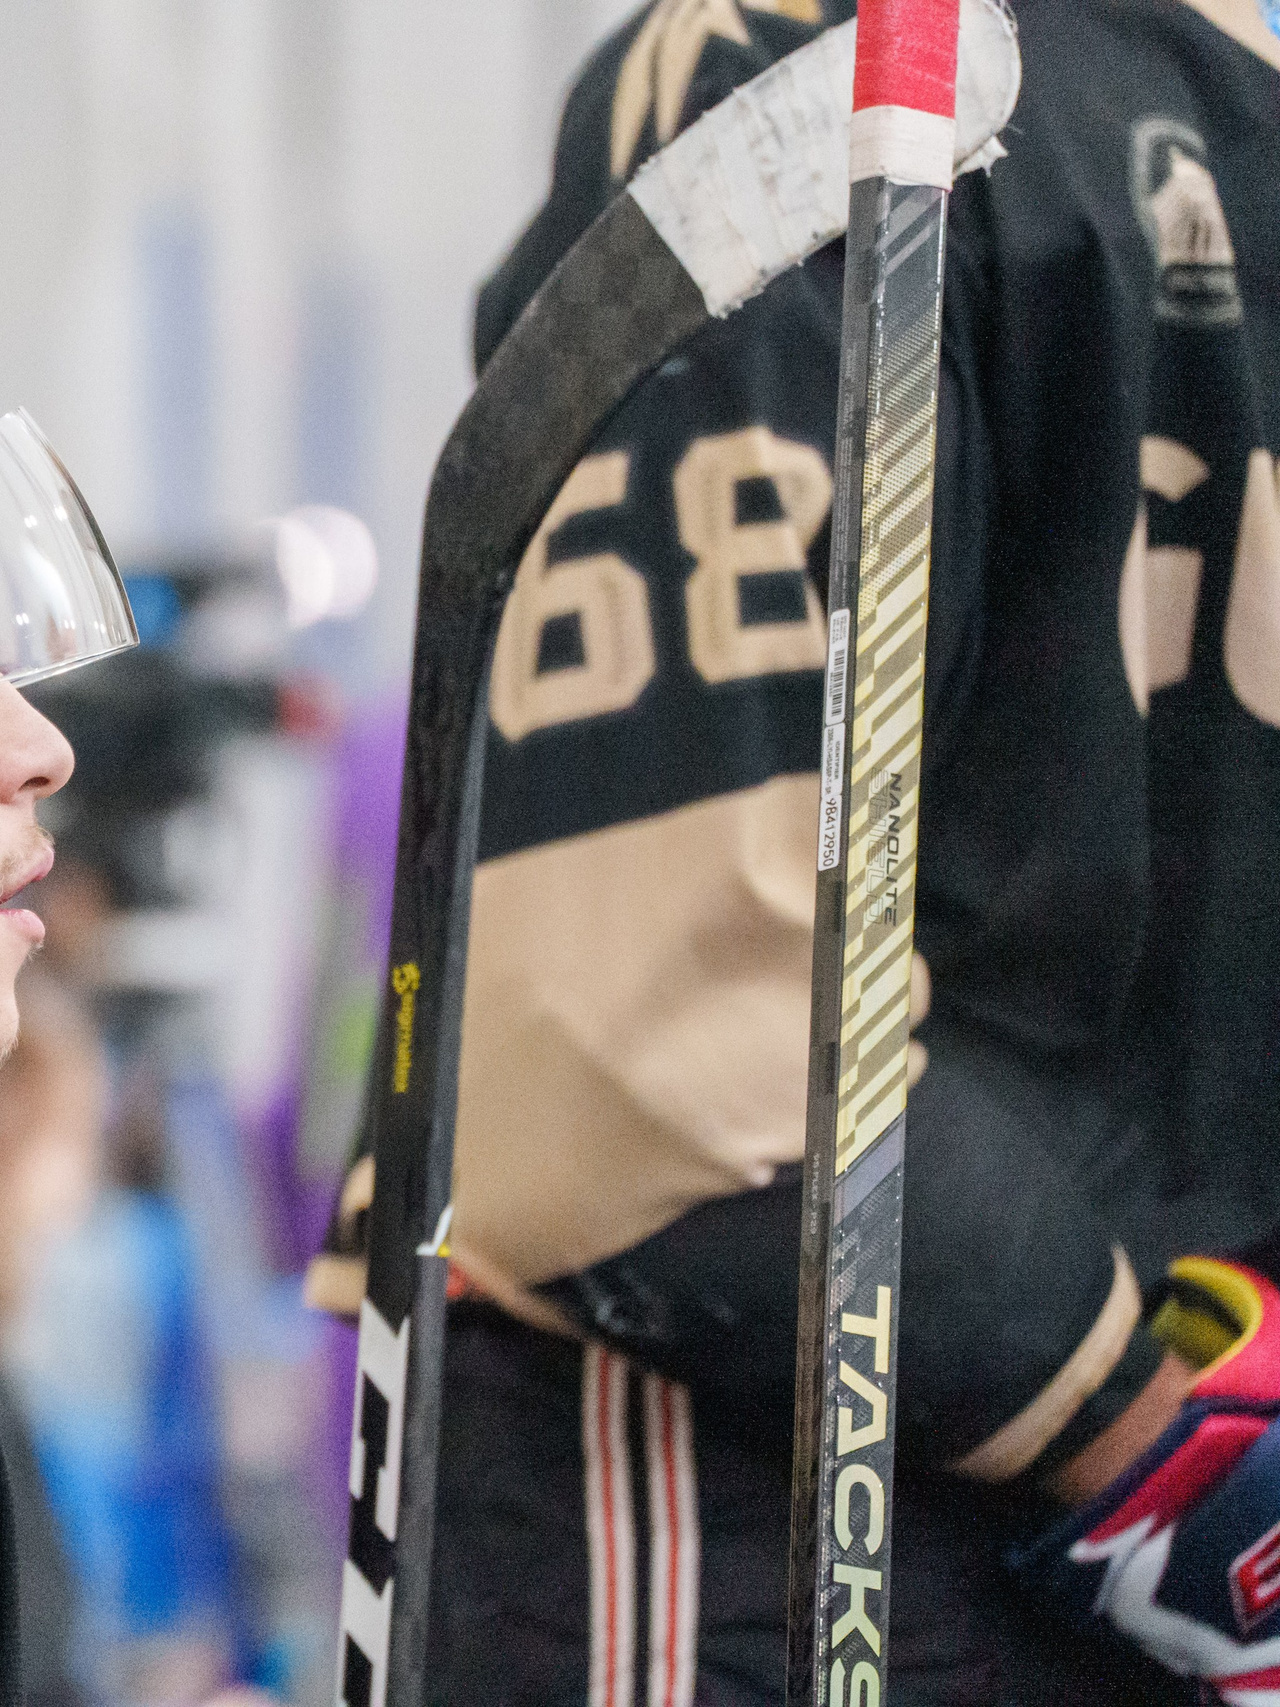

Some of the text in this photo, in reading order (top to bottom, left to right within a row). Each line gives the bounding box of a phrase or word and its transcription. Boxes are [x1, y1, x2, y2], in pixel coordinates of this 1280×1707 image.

[489, 425, 833, 741] 68
[823, 797, 838, 867] 98412950
[865, 768, 888, 924] SHIELD
[884, 773, 902, 926] NANOLITE
